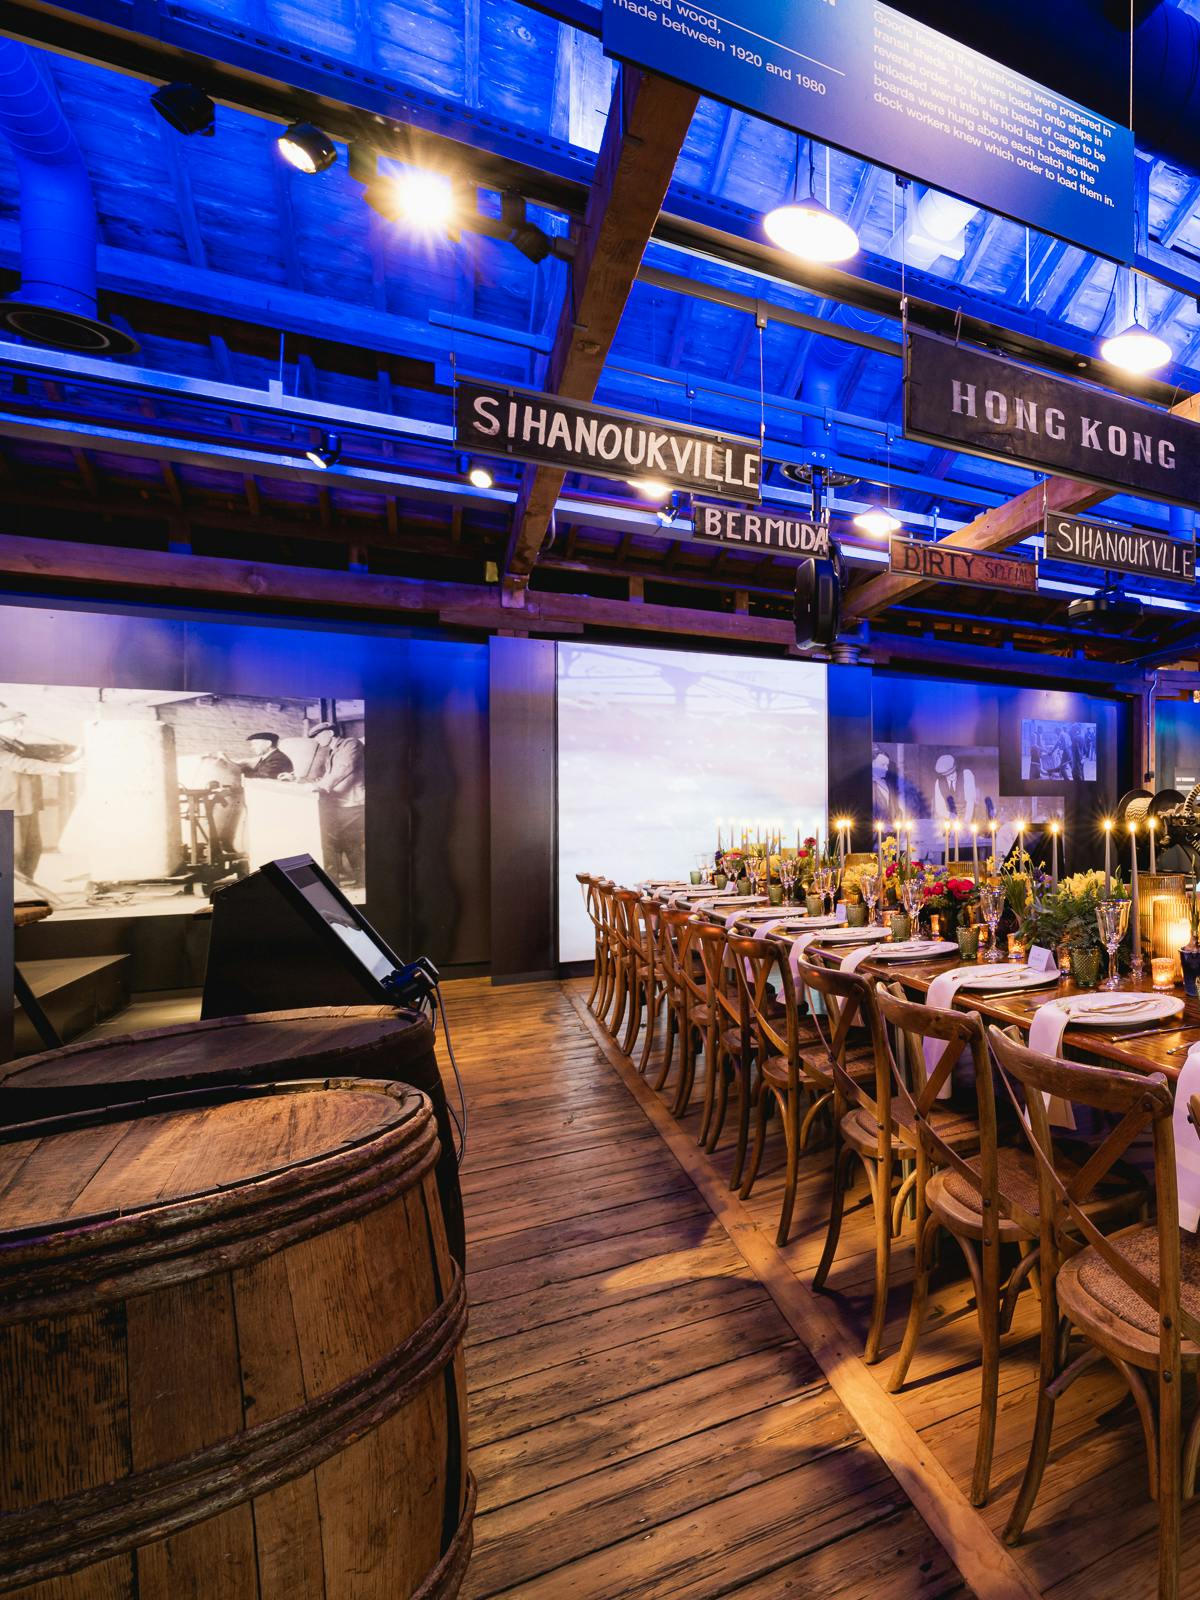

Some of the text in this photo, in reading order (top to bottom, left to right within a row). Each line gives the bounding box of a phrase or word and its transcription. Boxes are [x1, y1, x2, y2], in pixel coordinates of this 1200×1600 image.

[662, 13, 725, 52] between
[730, 44, 762, 67] 1920
[766, 62, 792, 81] and
[796, 73, 826, 95] 1980
[676, 3, 721, 34] wood,
[874, 10, 913, 37] Goods
[977, 64, 1032, 98] warehouse
[1034, 93, 1058, 110] were
[1060, 104, 1101, 131] prepared
[1103, 124, 1112, 138] in
[874, 26, 910, 53] transit
[952, 65, 978, 88] They
[981, 80, 1006, 99] were
[1008, 92, 1042, 117] loaded
[1044, 113, 1066, 129] onto
[1068, 124, 1092, 143] ships
[1094, 134, 1103, 148] in
[874, 44, 916, 71] reverse
[953, 83, 967, 96] so
[970, 88, 986, 105] the
[989, 97, 1009, 116] first
[1011, 108, 1039, 131] batch
[1041, 125, 1052, 137] of
[1053, 131, 1081, 150] cargo
[1082, 143, 1092, 155] to
[1093, 148, 1106, 162] be
[874, 60, 1099, 173] unloaded went into the hold last. Destination
[874, 73, 1095, 185] boards were hung above each batch so the
[874, 91, 1115, 208] dock workers knew which order to load them in.
[472, 395, 762, 489] SIHANOUKVILLE
[951, 378, 1177, 470] HONG KONG
[704, 507, 828, 553] BERMUDA
[904, 546, 975, 578] DIRTY
